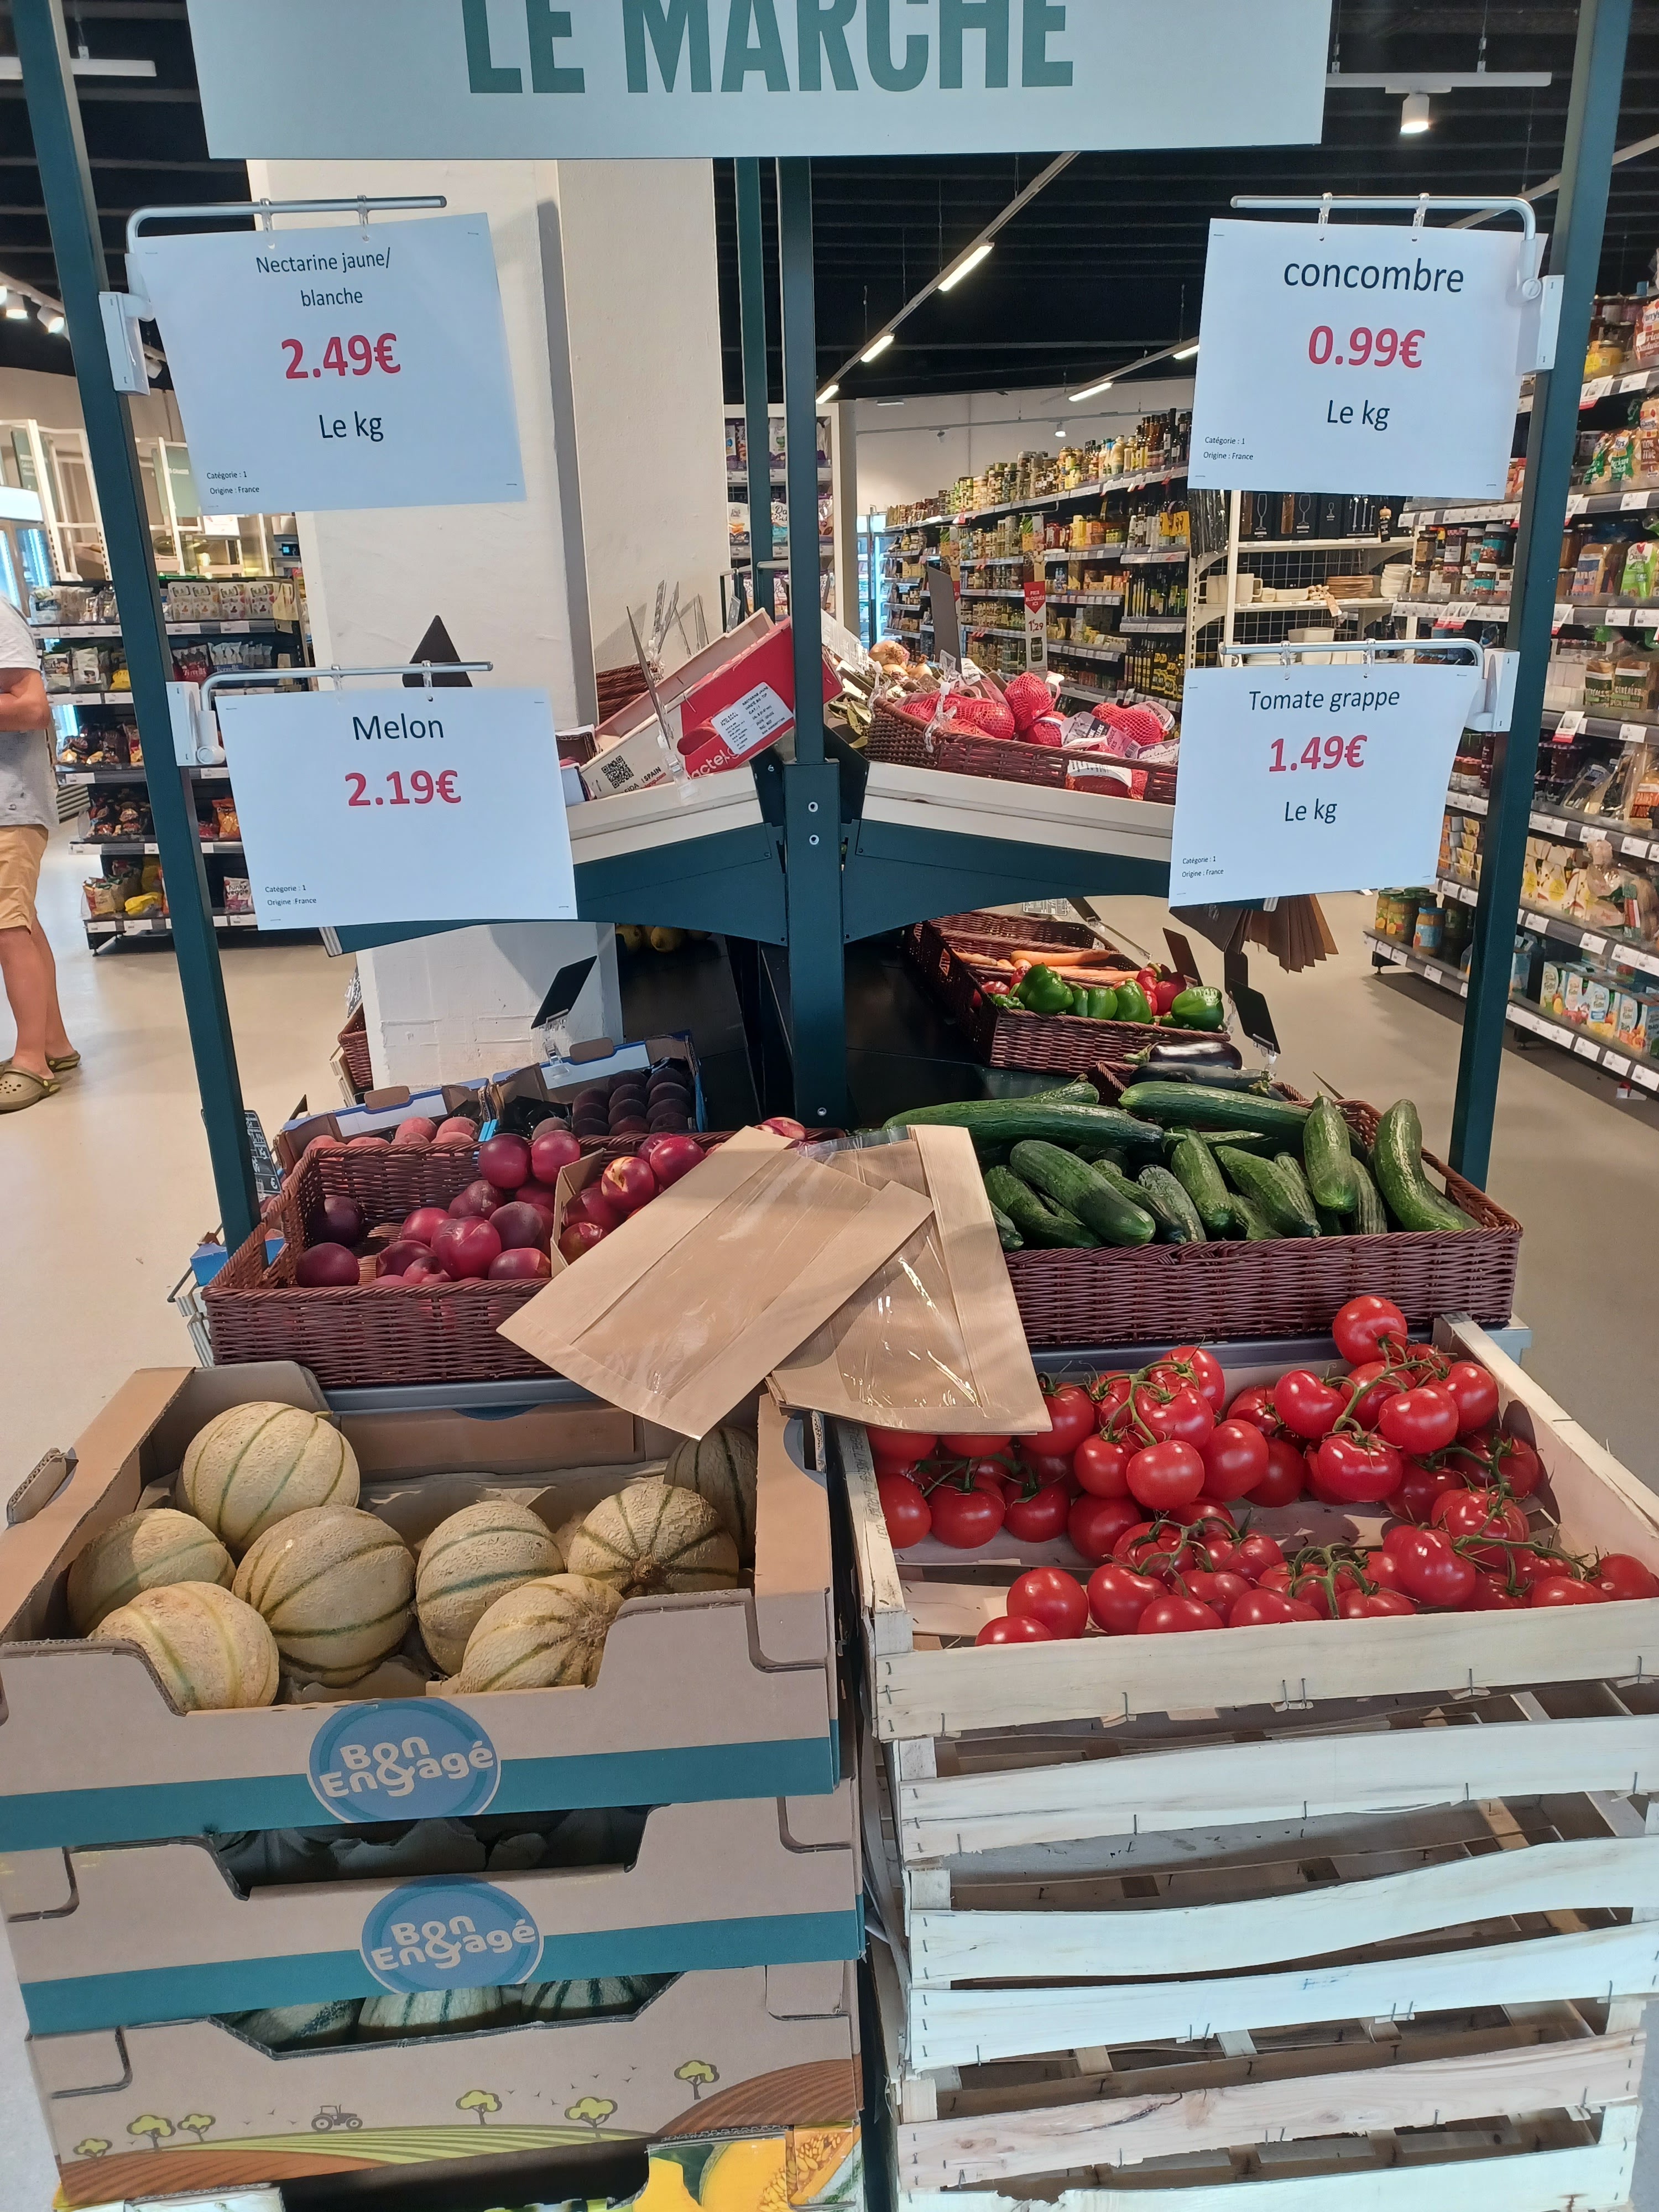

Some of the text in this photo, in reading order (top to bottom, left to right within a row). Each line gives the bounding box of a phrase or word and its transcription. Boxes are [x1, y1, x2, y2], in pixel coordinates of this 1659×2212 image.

[462, 0, 585, 93] LE
[255, 247, 390, 273] Nectarine jaune/
[1284, 257, 1464, 293] concombre
[300, 287, 363, 307] blanche
[281, 332, 401, 380] 2.49€
[1308, 325, 1426, 368] 0.99€
[319, 410, 384, 442] Le kg
[1327, 399, 1390, 431] Le kg
[1204, 436, 1236, 445] Catégorie
[1203, 451, 1227, 460] Origine
[206, 471, 238, 480] Catégorie
[210, 487, 233, 495] Origine
[1249, 690, 1400, 713] Tomate grappe
[352, 713, 444, 740] Melon
[1269, 734, 1368, 773] 1.49€
[644, 766, 662, 781] SPAIN
[345, 769, 462, 807] 2.19€
[1285, 798, 1338, 824] Le kg
[265, 885, 297, 893] Catégorie
